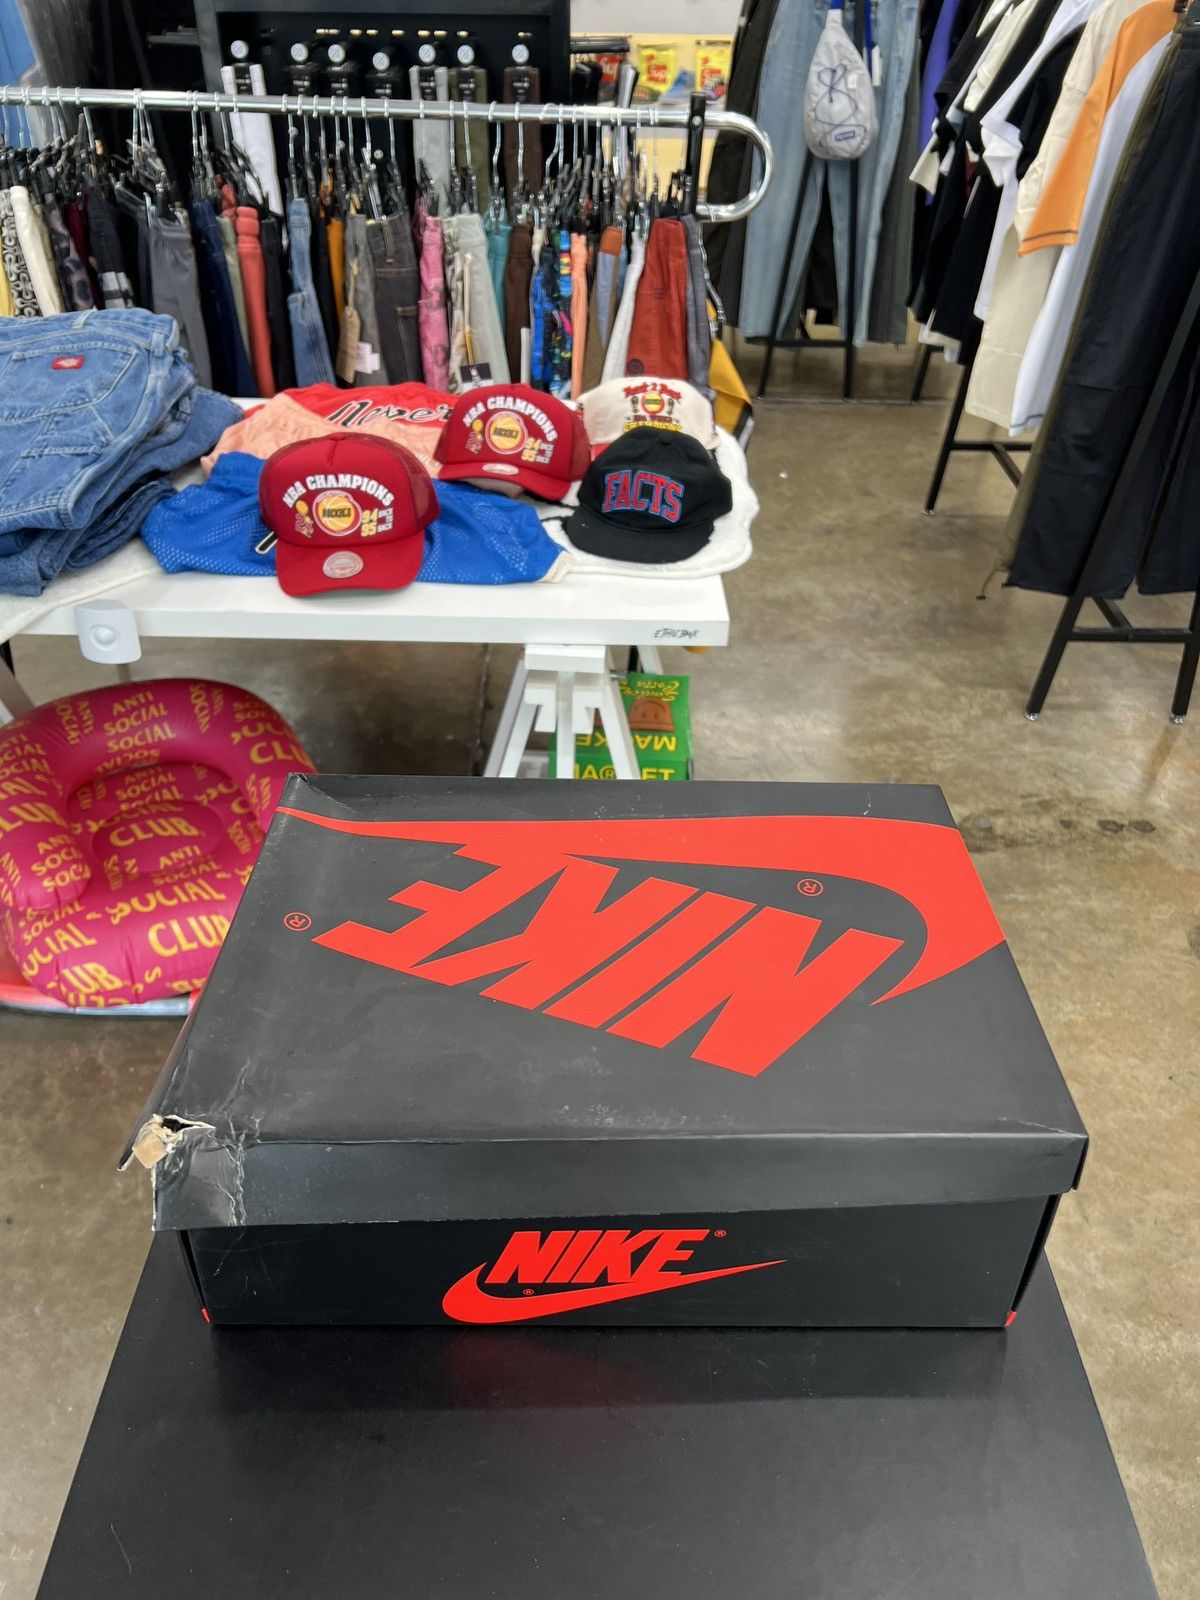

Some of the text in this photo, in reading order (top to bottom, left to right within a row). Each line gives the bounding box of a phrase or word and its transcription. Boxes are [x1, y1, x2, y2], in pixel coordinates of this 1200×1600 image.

[462, 395, 558, 442] NBA CHAMPIONS
[282, 473, 395, 509] NBA CHAMPIONS
[601, 469, 685, 523] FACTS
[103, 701, 169, 737] SOCIAL
[112, 691, 154, 716] ANTI
[107, 721, 177, 754] SOCIAL
[0, 758, 54, 780] OCIAL
[109, 816, 200, 847] CLUB
[31, 847, 81, 876] SOCI
[159, 845, 201, 870] ANTI
[22, 921, 98, 977] OCIAL
[311, 843, 905, 1076] NIKE
[484, 1228, 711, 1284] NIKE
